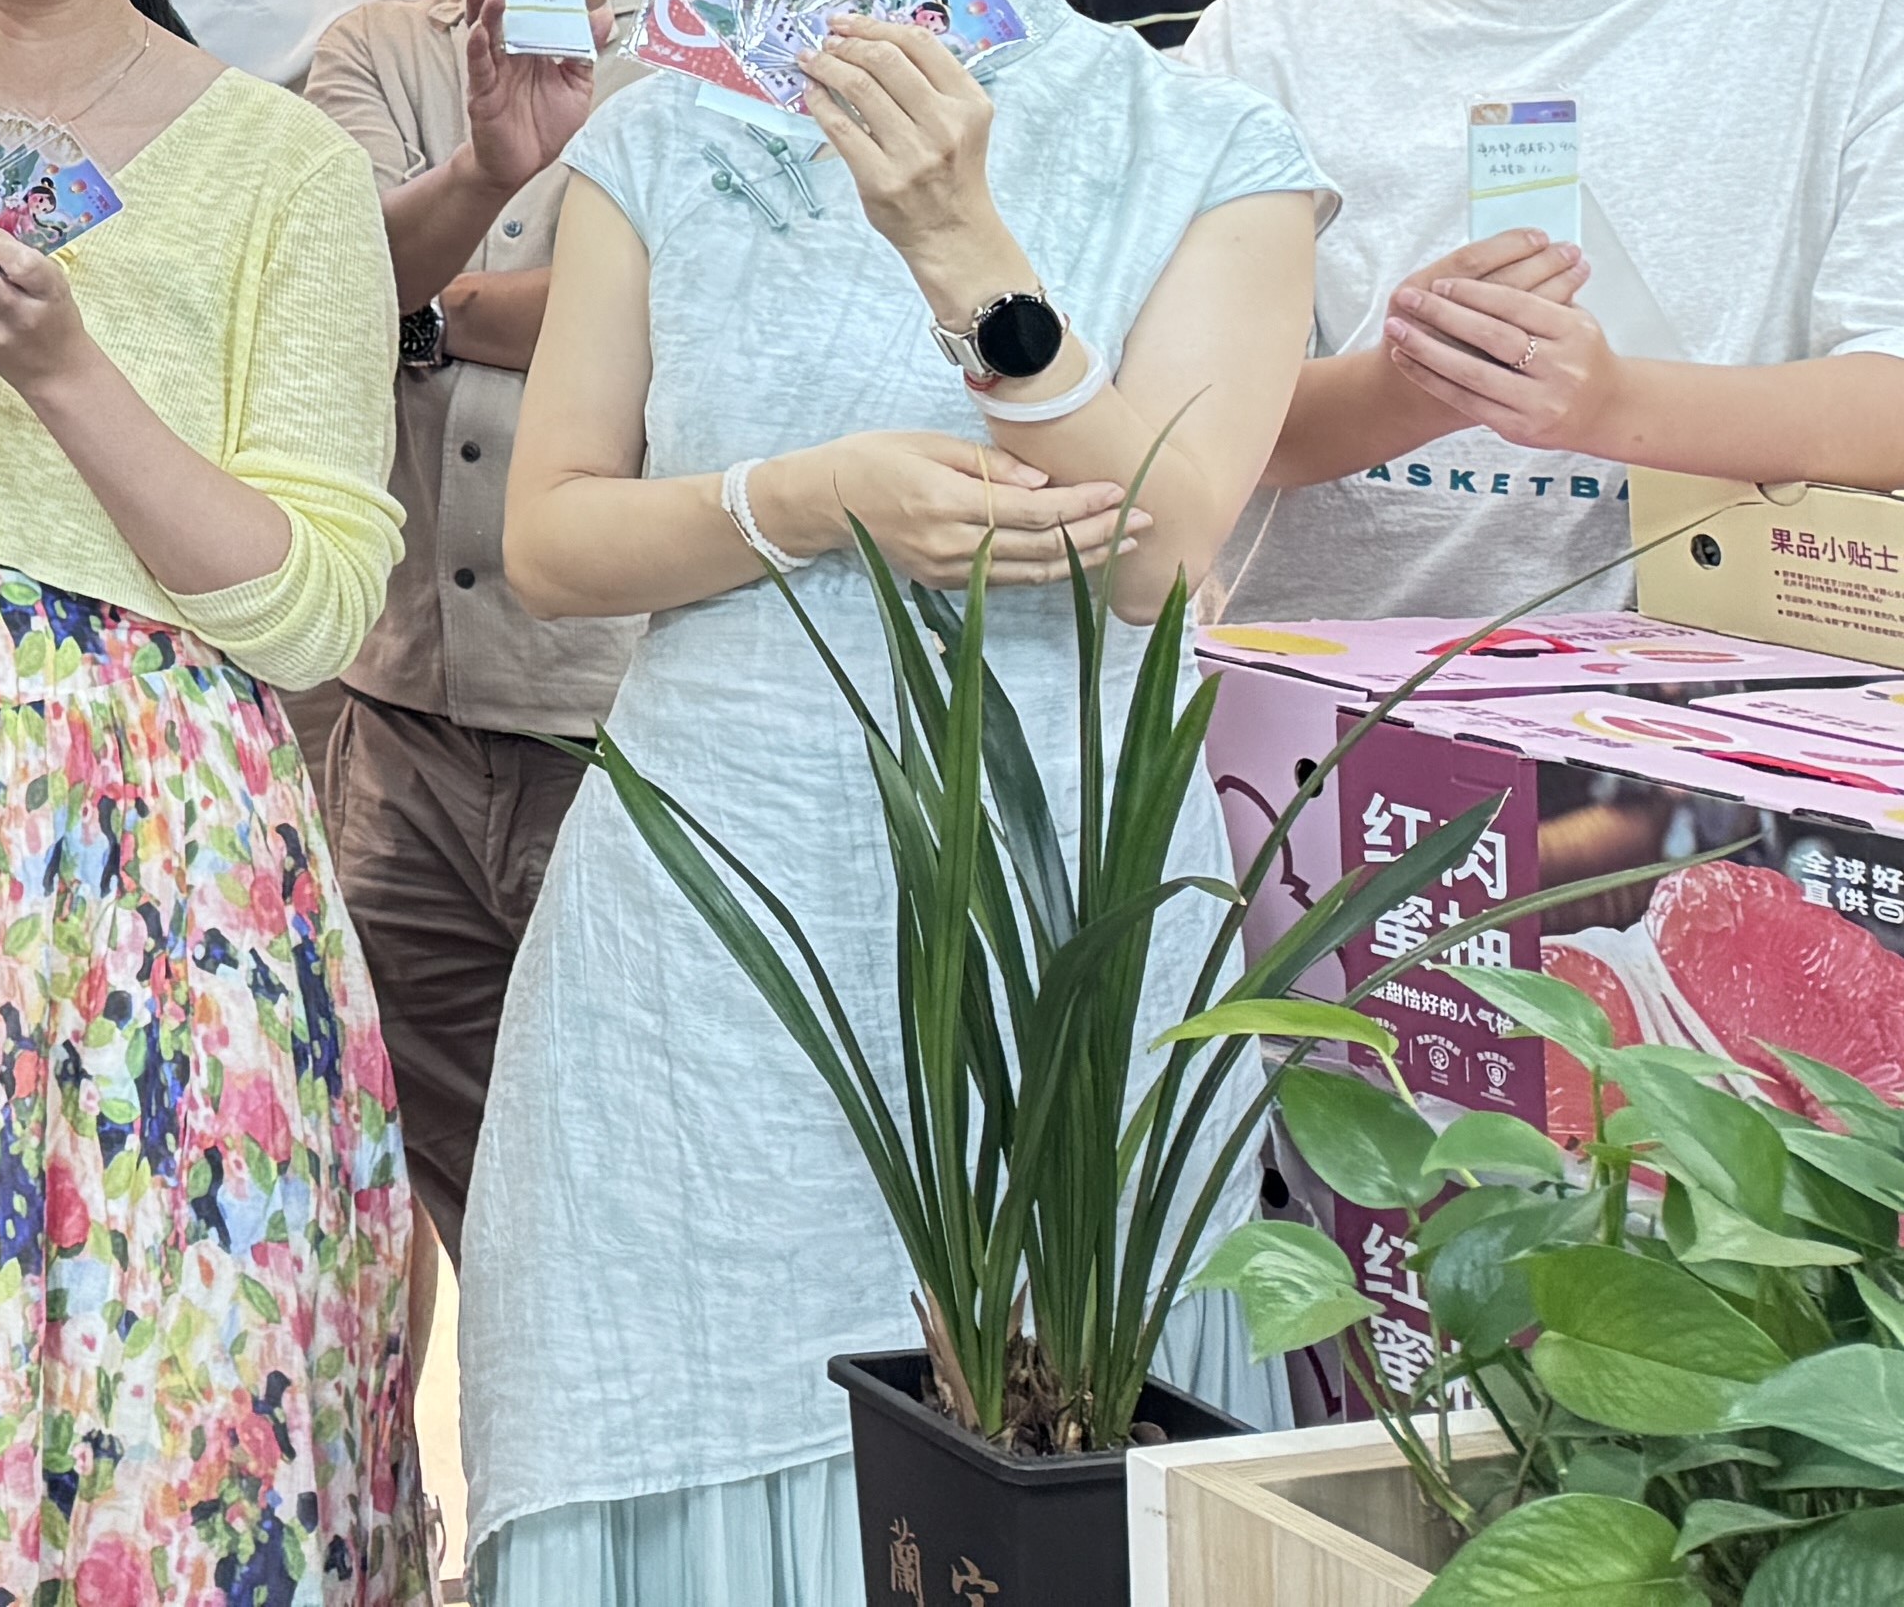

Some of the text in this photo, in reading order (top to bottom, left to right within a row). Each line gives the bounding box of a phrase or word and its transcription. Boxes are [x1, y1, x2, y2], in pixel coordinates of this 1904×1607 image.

[1771, 527, 1899, 573] 果品小贴士
